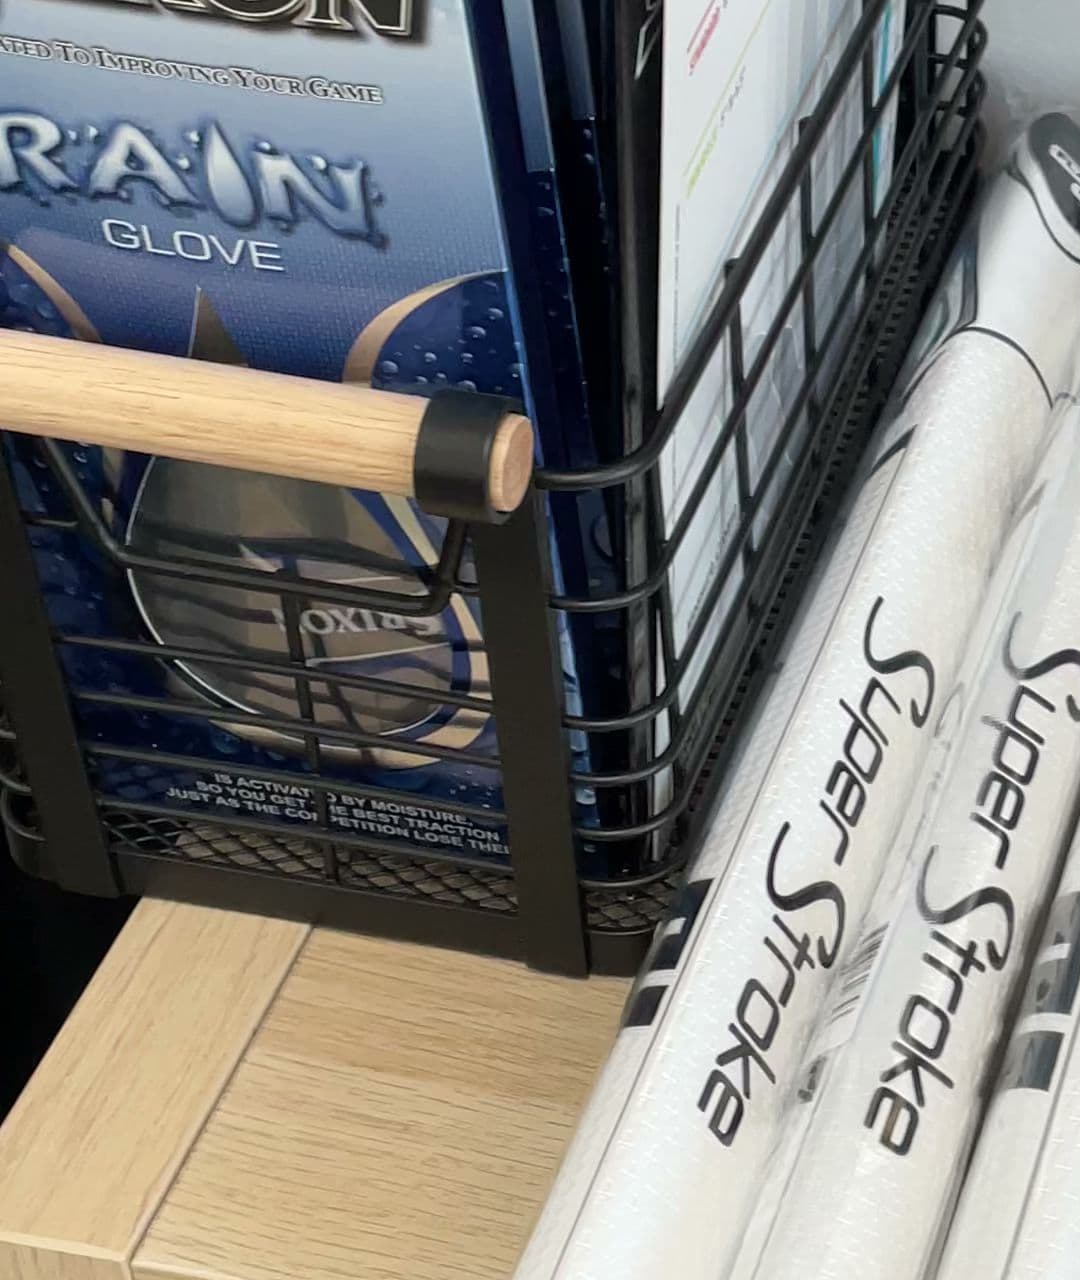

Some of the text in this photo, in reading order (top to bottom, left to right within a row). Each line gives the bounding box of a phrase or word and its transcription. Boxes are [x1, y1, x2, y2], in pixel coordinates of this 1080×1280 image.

[0, 110, 388, 249] RAIN
[101, 217, 285, 272] GLOVE
[196, 780, 223, 794] SO
[225, 786, 267, 802] YOU
[269, 794, 306, 809] GET
[237, 777, 336, 803] ACTIVAT
[341, 792, 370, 807] BY
[166, 787, 212, 803] JUST
[216, 796, 241, 808] AS
[243, 801, 281, 816] THE
[285, 808, 410, 838] COETITION
[414, 830, 465, 848] LOSE
[352, 808, 400, 825] BEST
[404, 818, 501, 842] TRACTION
